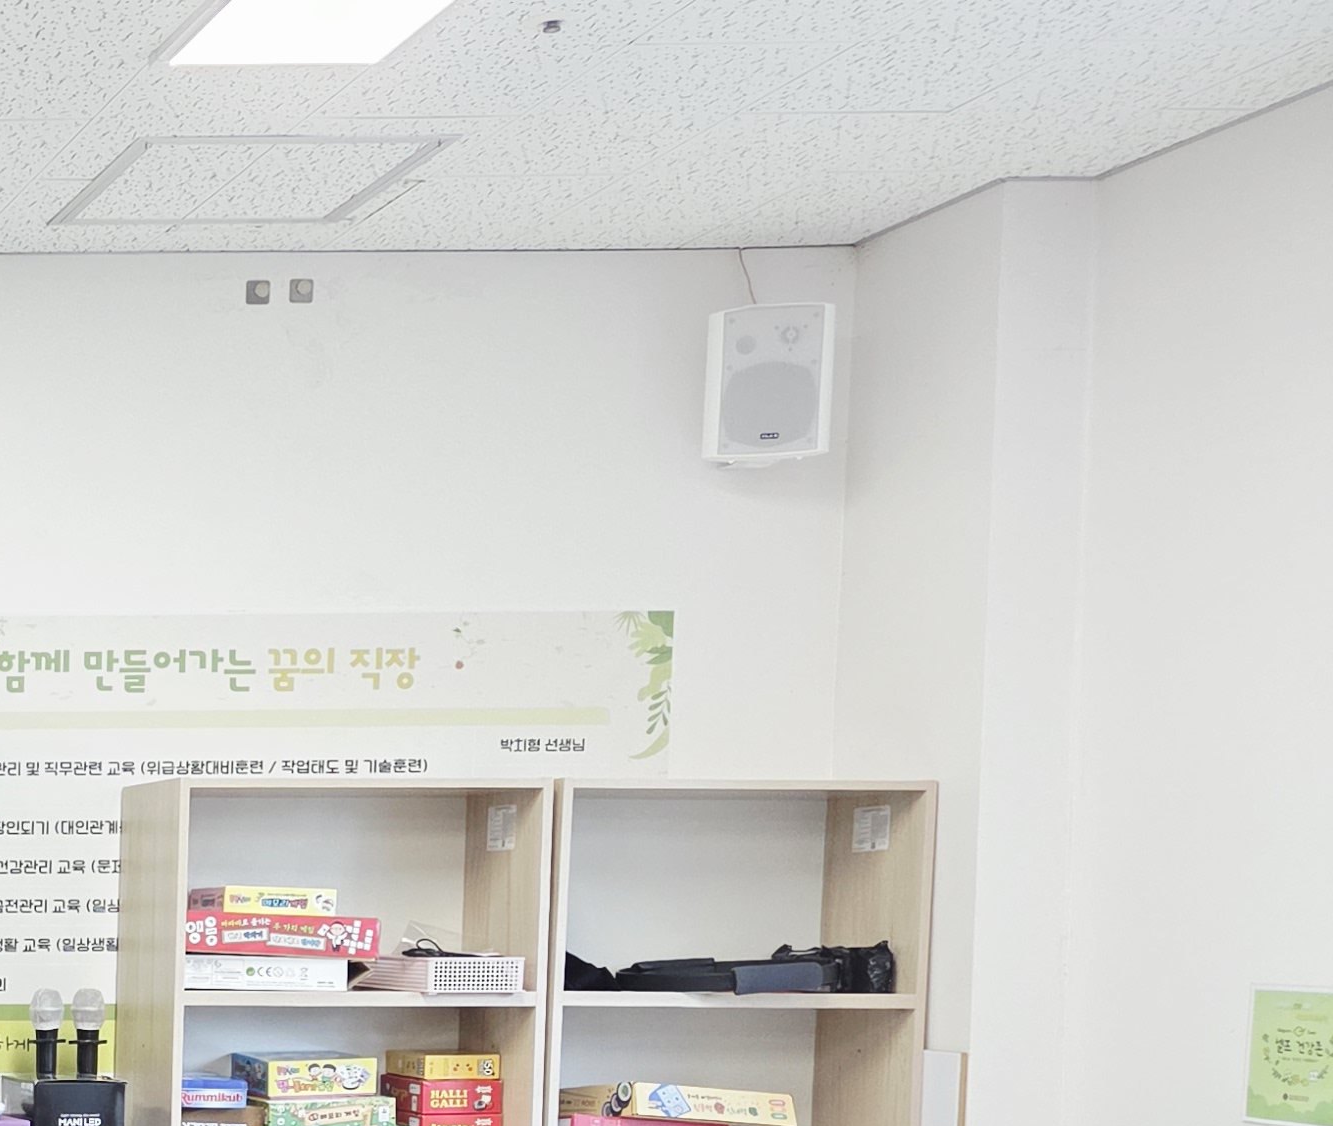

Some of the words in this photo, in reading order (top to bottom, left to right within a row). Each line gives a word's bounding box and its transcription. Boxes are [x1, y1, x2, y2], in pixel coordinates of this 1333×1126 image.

[84, 648, 256, 692] 만들어가는
[267, 647, 335, 692] 꿈의
[349, 647, 421, 690] 직장
[544, 737, 586, 753] 선생님
[26, 762, 40, 776] 및
[44, 761, 103, 776] 직무관련
[106, 761, 136, 776] 교육
[281, 759, 340, 775] 작업태도
[344, 759, 359, 775] 및
[364, 758, 428, 774] 기술훈련)
[55, 820, 124, 835] (대인관계
[57, 860, 86, 874] 교육
[52, 899, 80, 913] 교육
[23, 938, 51, 952] 교육
[182, 1091, 242, 1105] Rummikub
[430, 1090, 468, 1099] HALLI
[430, 1099, 468, 1108] GALLI
